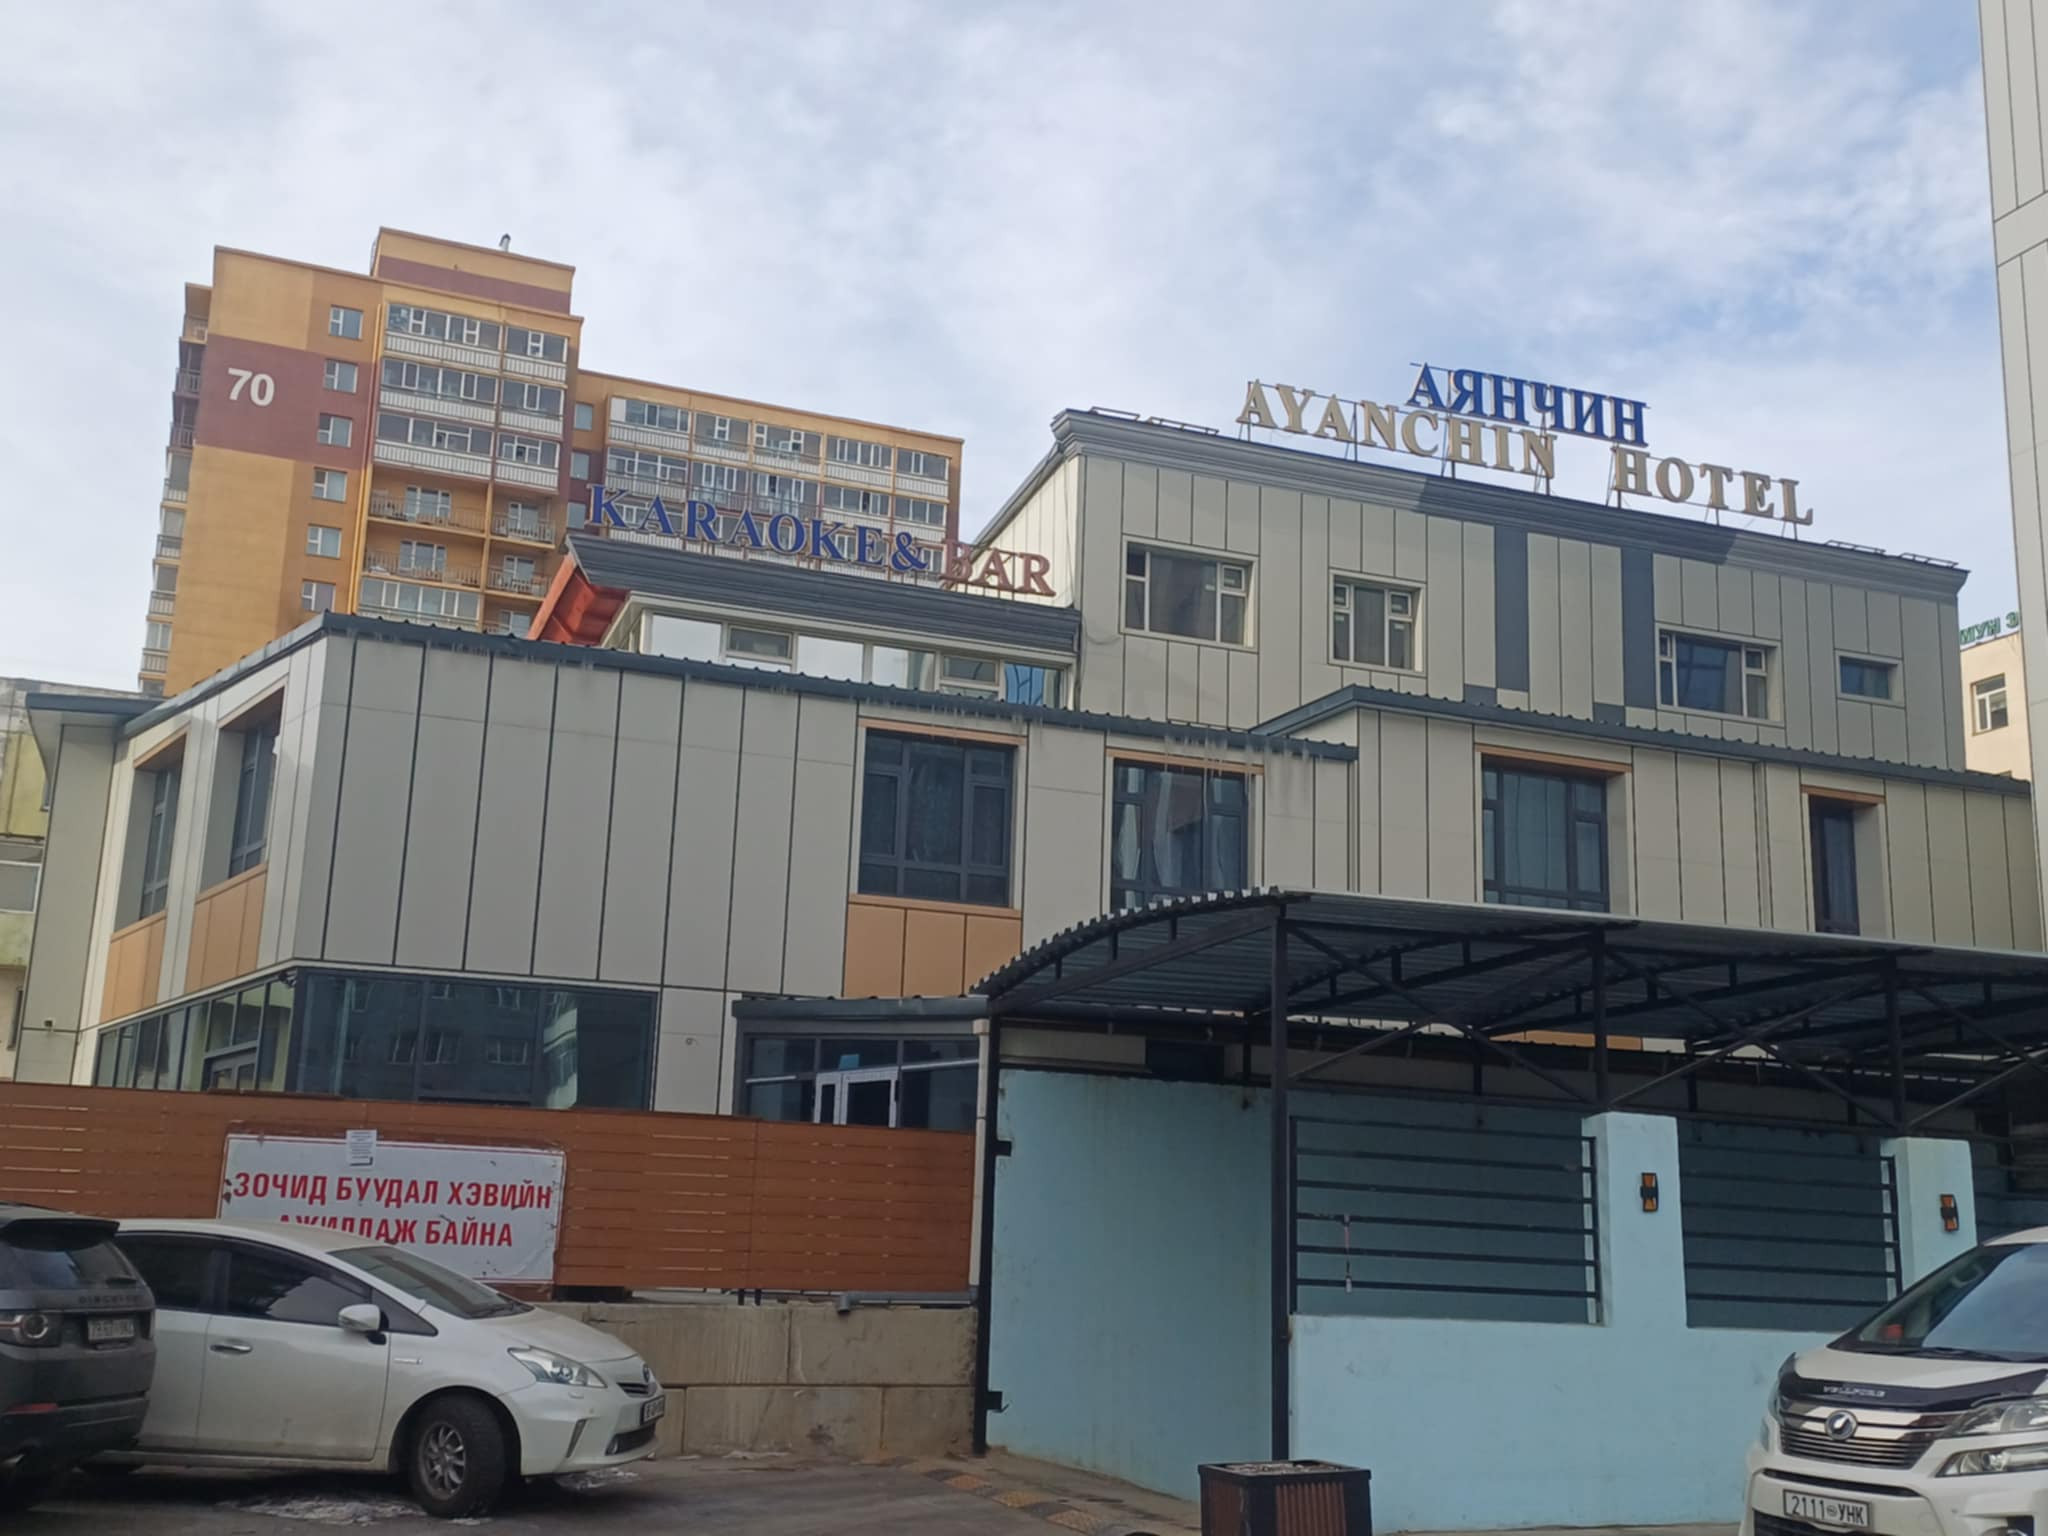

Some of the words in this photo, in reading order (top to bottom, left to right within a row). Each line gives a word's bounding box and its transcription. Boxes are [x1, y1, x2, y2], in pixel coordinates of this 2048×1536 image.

[227, 367, 275, 407] 70
[1406, 362, 1650, 447] АЯНЧИН
[1236, 379, 1557, 480] AYANCHIN
[1610, 446, 1814, 526] HOTEL
[939, 540, 1056, 597] BAR
[233, 1172, 327, 1205] ЗОЧИД
[336, 1176, 439, 1209] БУУДАЛ
[447, 1178, 552, 1209] ХЭВИЙН
[280, 1214, 417, 1244] ИЛЛАЖ
[425, 1216, 513, 1248] БАЙНА
[1791, 1495, 1826, 1521] 2111
[1837, 1503, 1865, 1525] УНК
